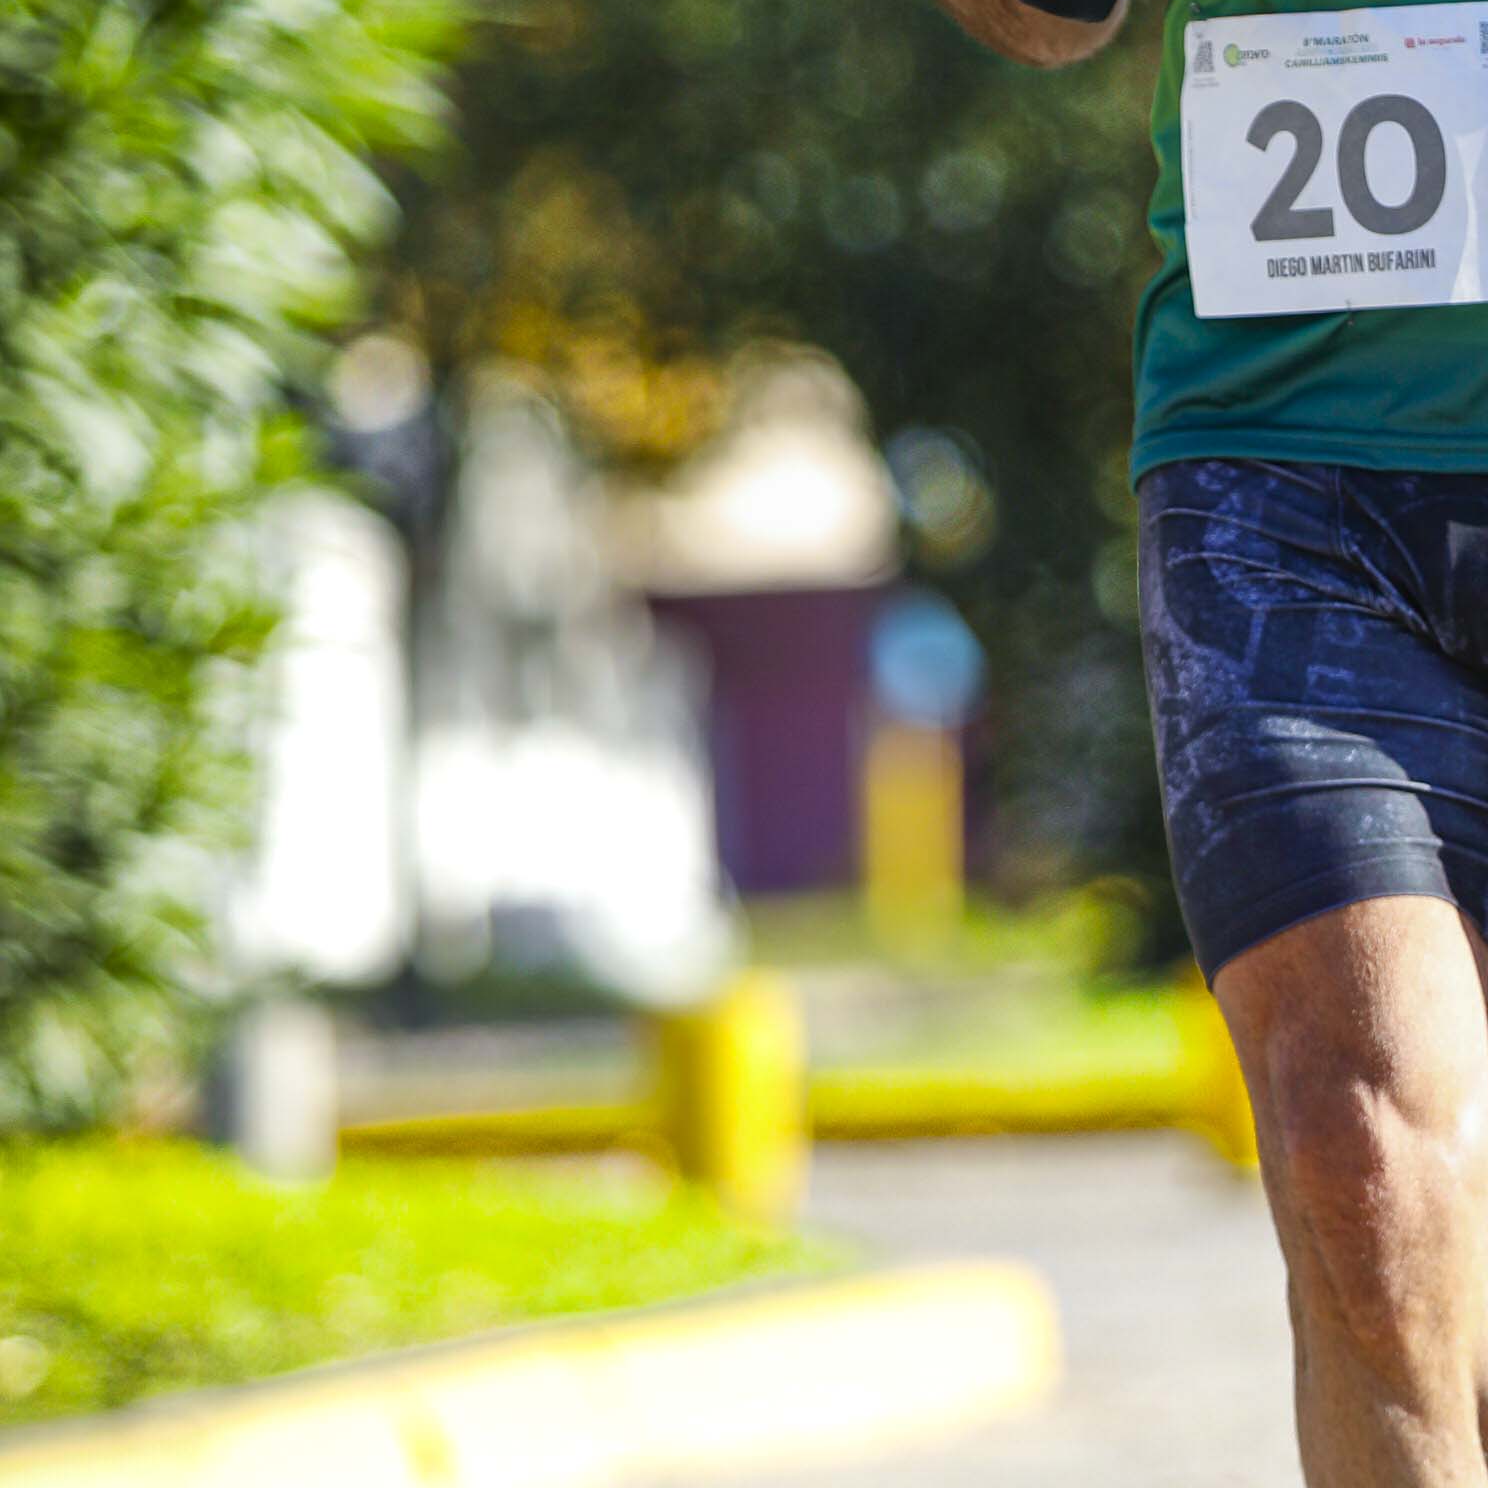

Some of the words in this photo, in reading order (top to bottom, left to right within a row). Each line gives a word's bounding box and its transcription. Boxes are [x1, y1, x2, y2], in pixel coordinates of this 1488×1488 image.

[1245, 93, 1447, 242] 20
[1267, 256, 1307, 278] DIEGO
[1310, 252, 1364, 276] MARTIN
[1367, 248, 1436, 272] BUFARINI
